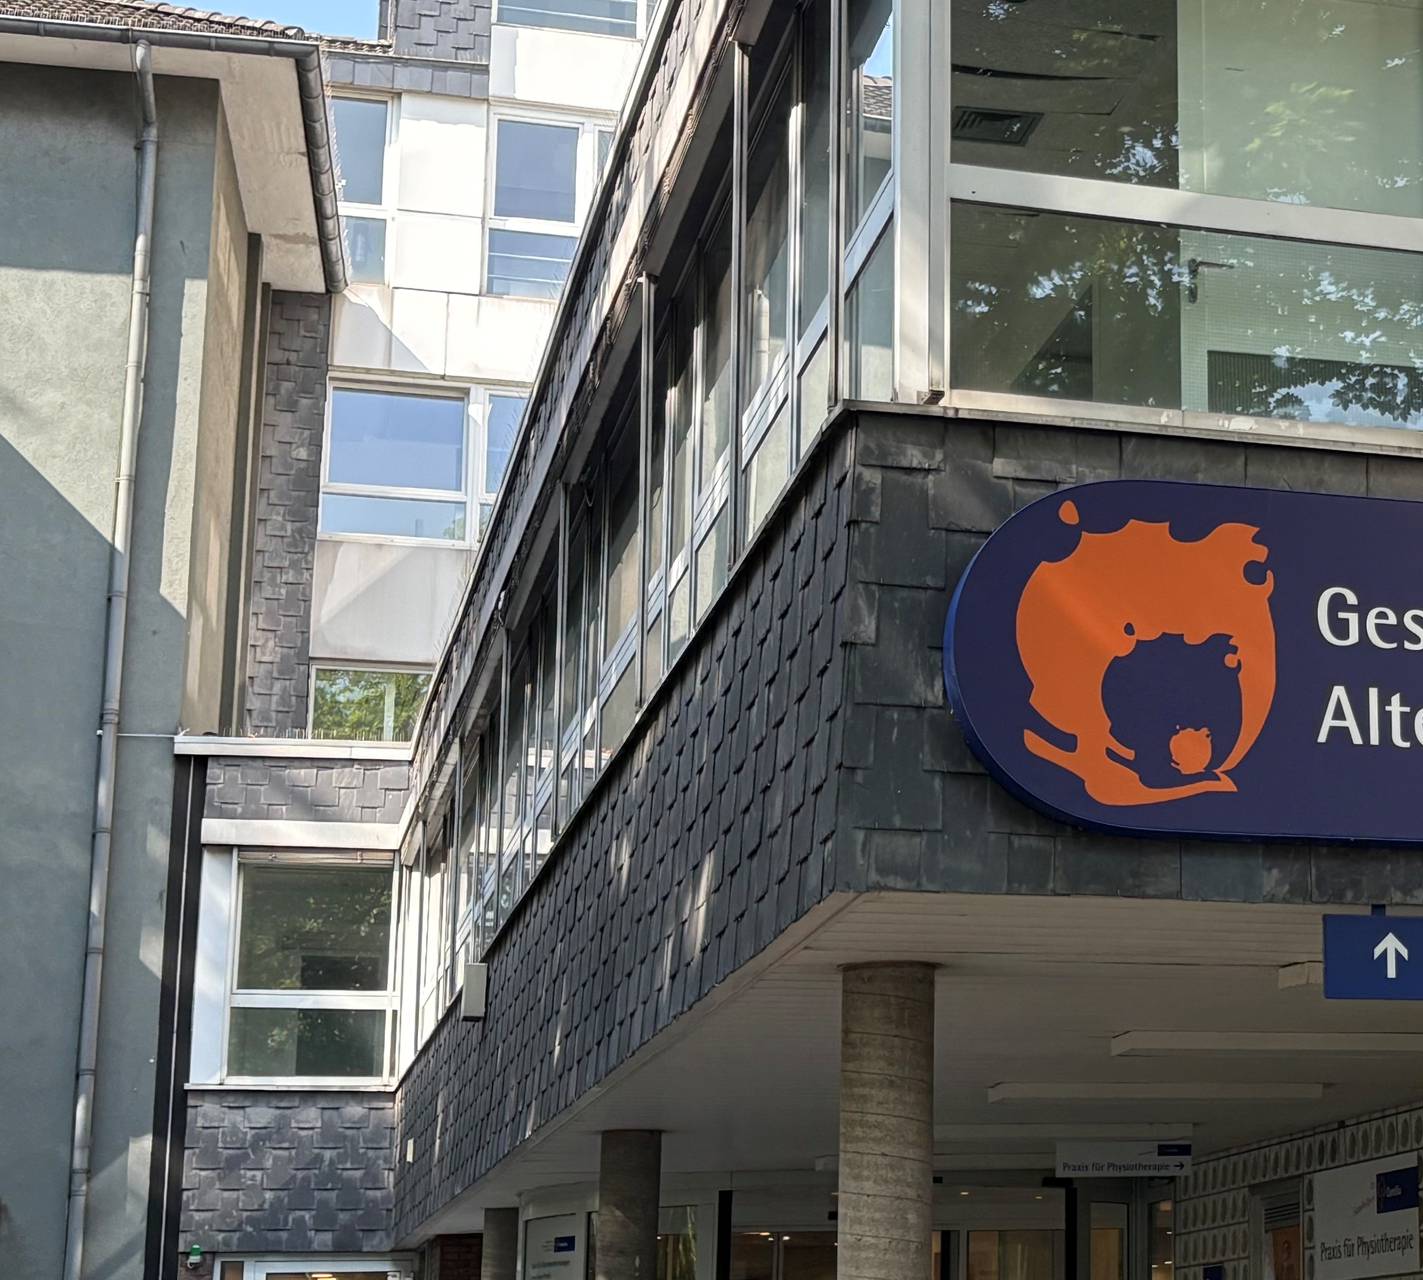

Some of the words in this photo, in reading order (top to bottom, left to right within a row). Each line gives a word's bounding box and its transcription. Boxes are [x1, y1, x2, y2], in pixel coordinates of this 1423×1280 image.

[1062, 1162, 1088, 1172] Praxis
[1091, 1161, 1105, 1172] für
[1107, 1161, 1170, 1174] Physiotherapie
[1320, 1240, 1343, 1261] Praxis
[1343, 1237, 1355, 1258] für
[1357, 1230, 1414, 1261] Physiotherapie
